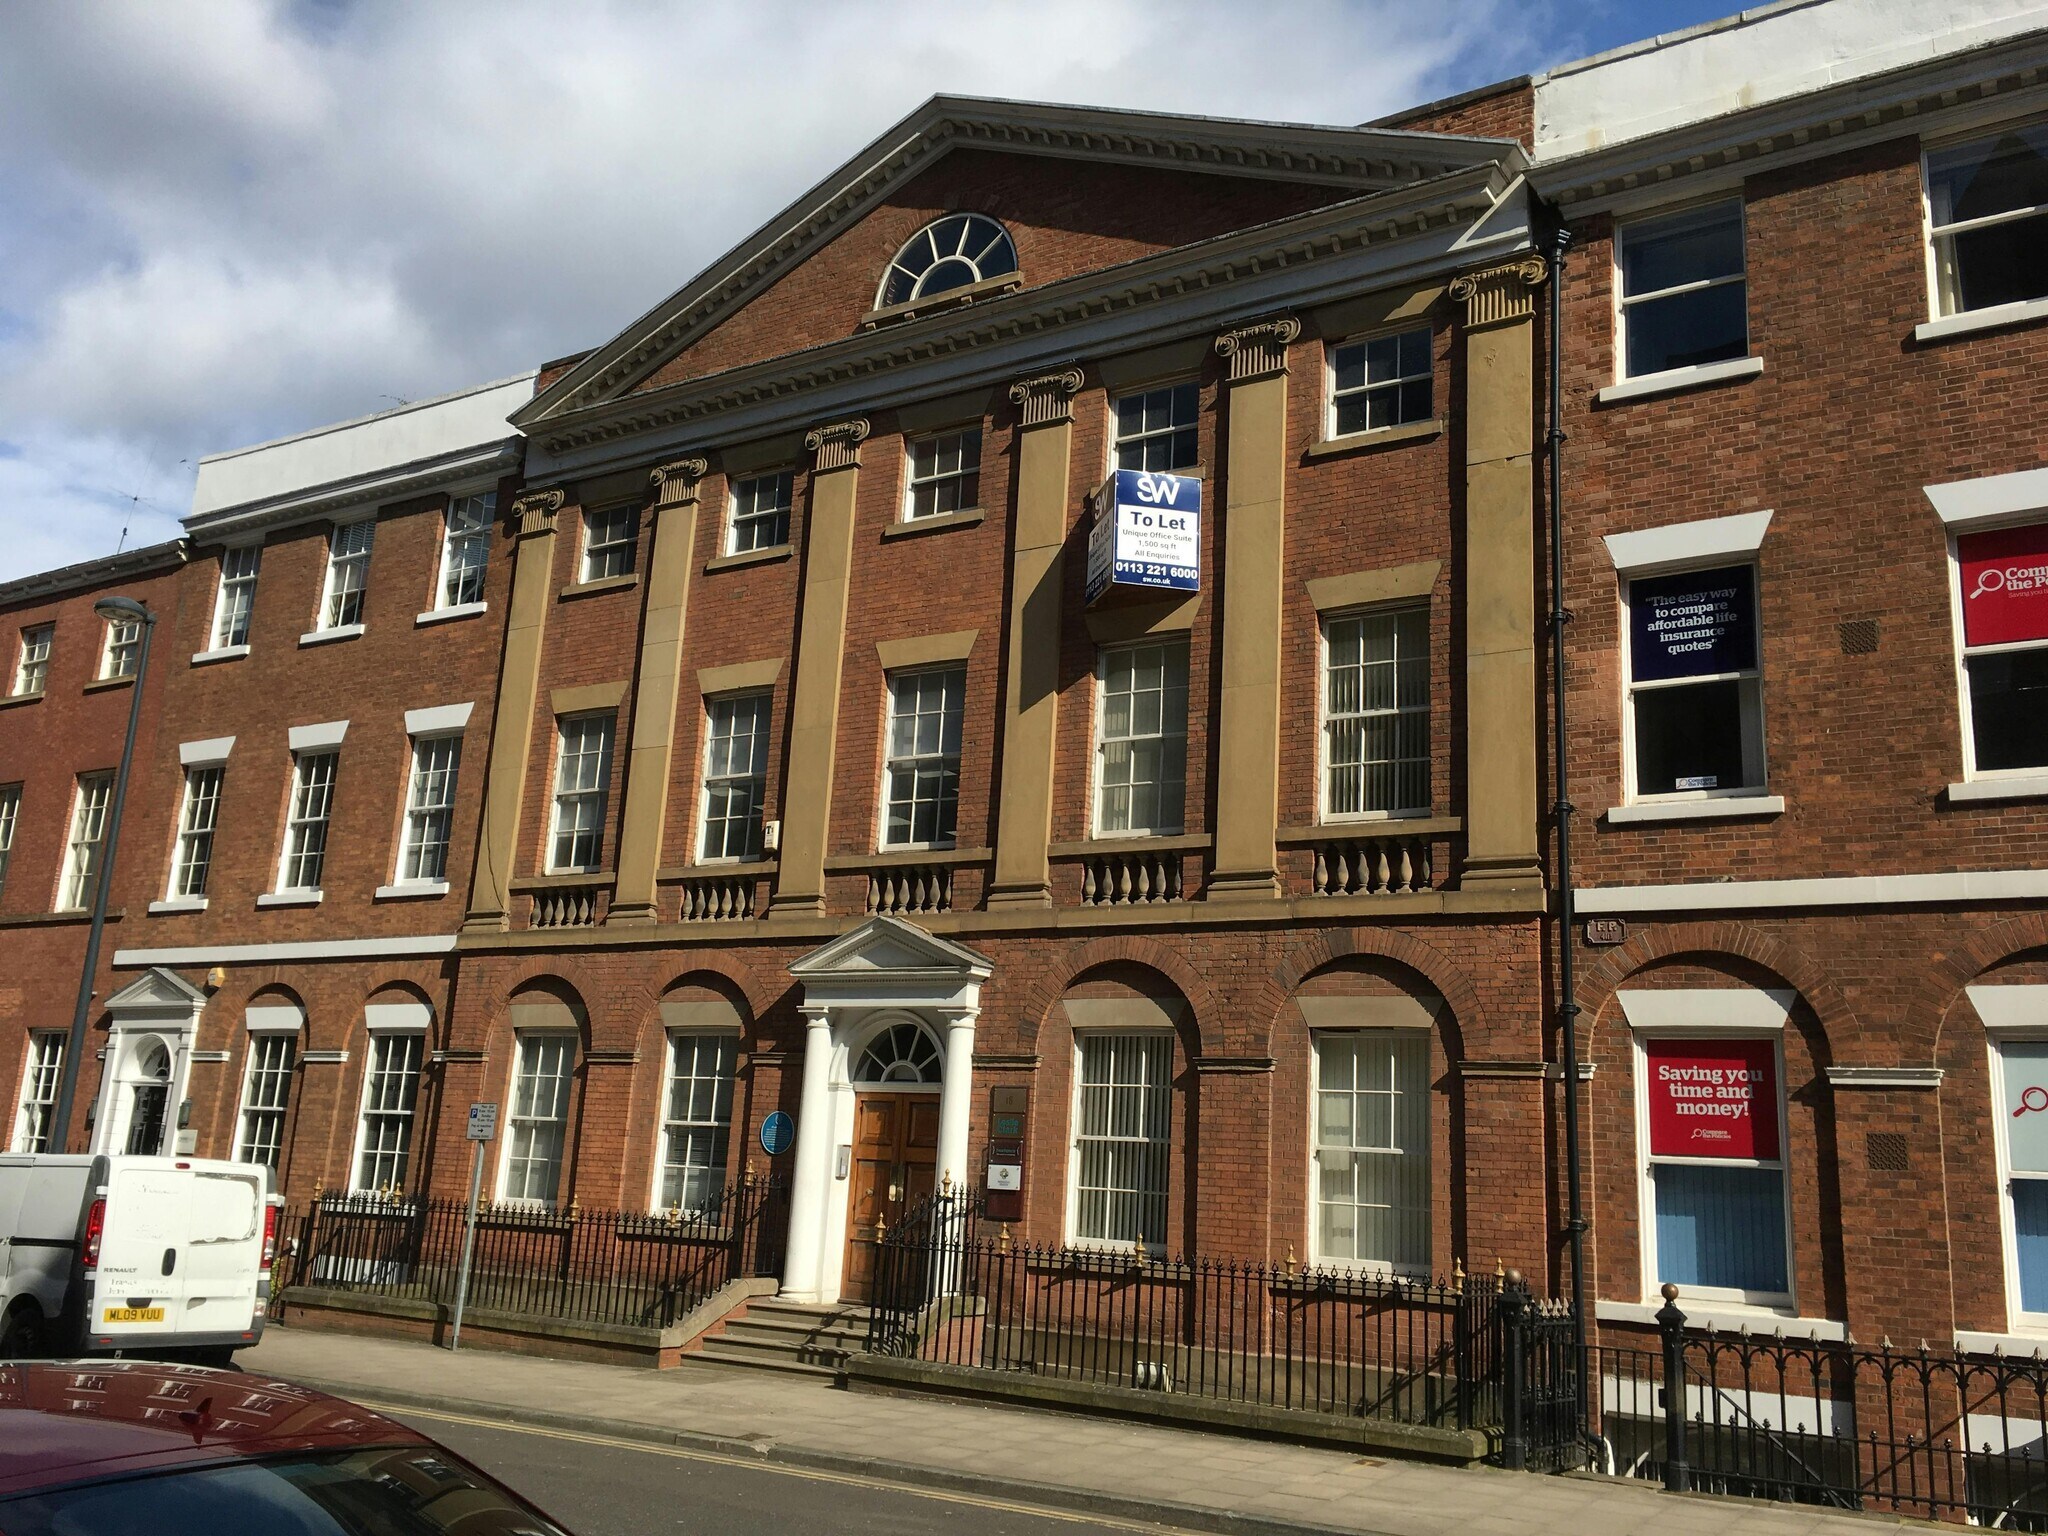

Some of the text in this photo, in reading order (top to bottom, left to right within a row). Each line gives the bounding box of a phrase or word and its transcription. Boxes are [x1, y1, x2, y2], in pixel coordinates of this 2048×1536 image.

[1137, 477, 1180, 505] SW
[1131, 511, 1186, 530] To Let
[1092, 532, 1099, 546] To
[1122, 529, 1192, 542] Unique Office Suite
[1146, 551, 1180, 560] Enquiries
[1116, 562, 1143, 573] 0113
[1147, 564, 1166, 576] 221
[1171, 567, 1197, 579] 6000
[2006, 580, 2032, 591] the
[1678, 592, 1707, 603] easy
[1710, 588, 1737, 598] way
[1655, 602, 1728, 618] to compare
[1647, 612, 1737, 631] affordable life
[1660, 627, 1725, 642] insurance
[1659, 1065, 1763, 1084] Saving you
[1669, 1082, 1754, 1099] time and
[472, 1109, 477, 1117] P
[1676, 1101, 1749, 1119] money!
[109, 1309, 160, 1320] ML09 VUU
